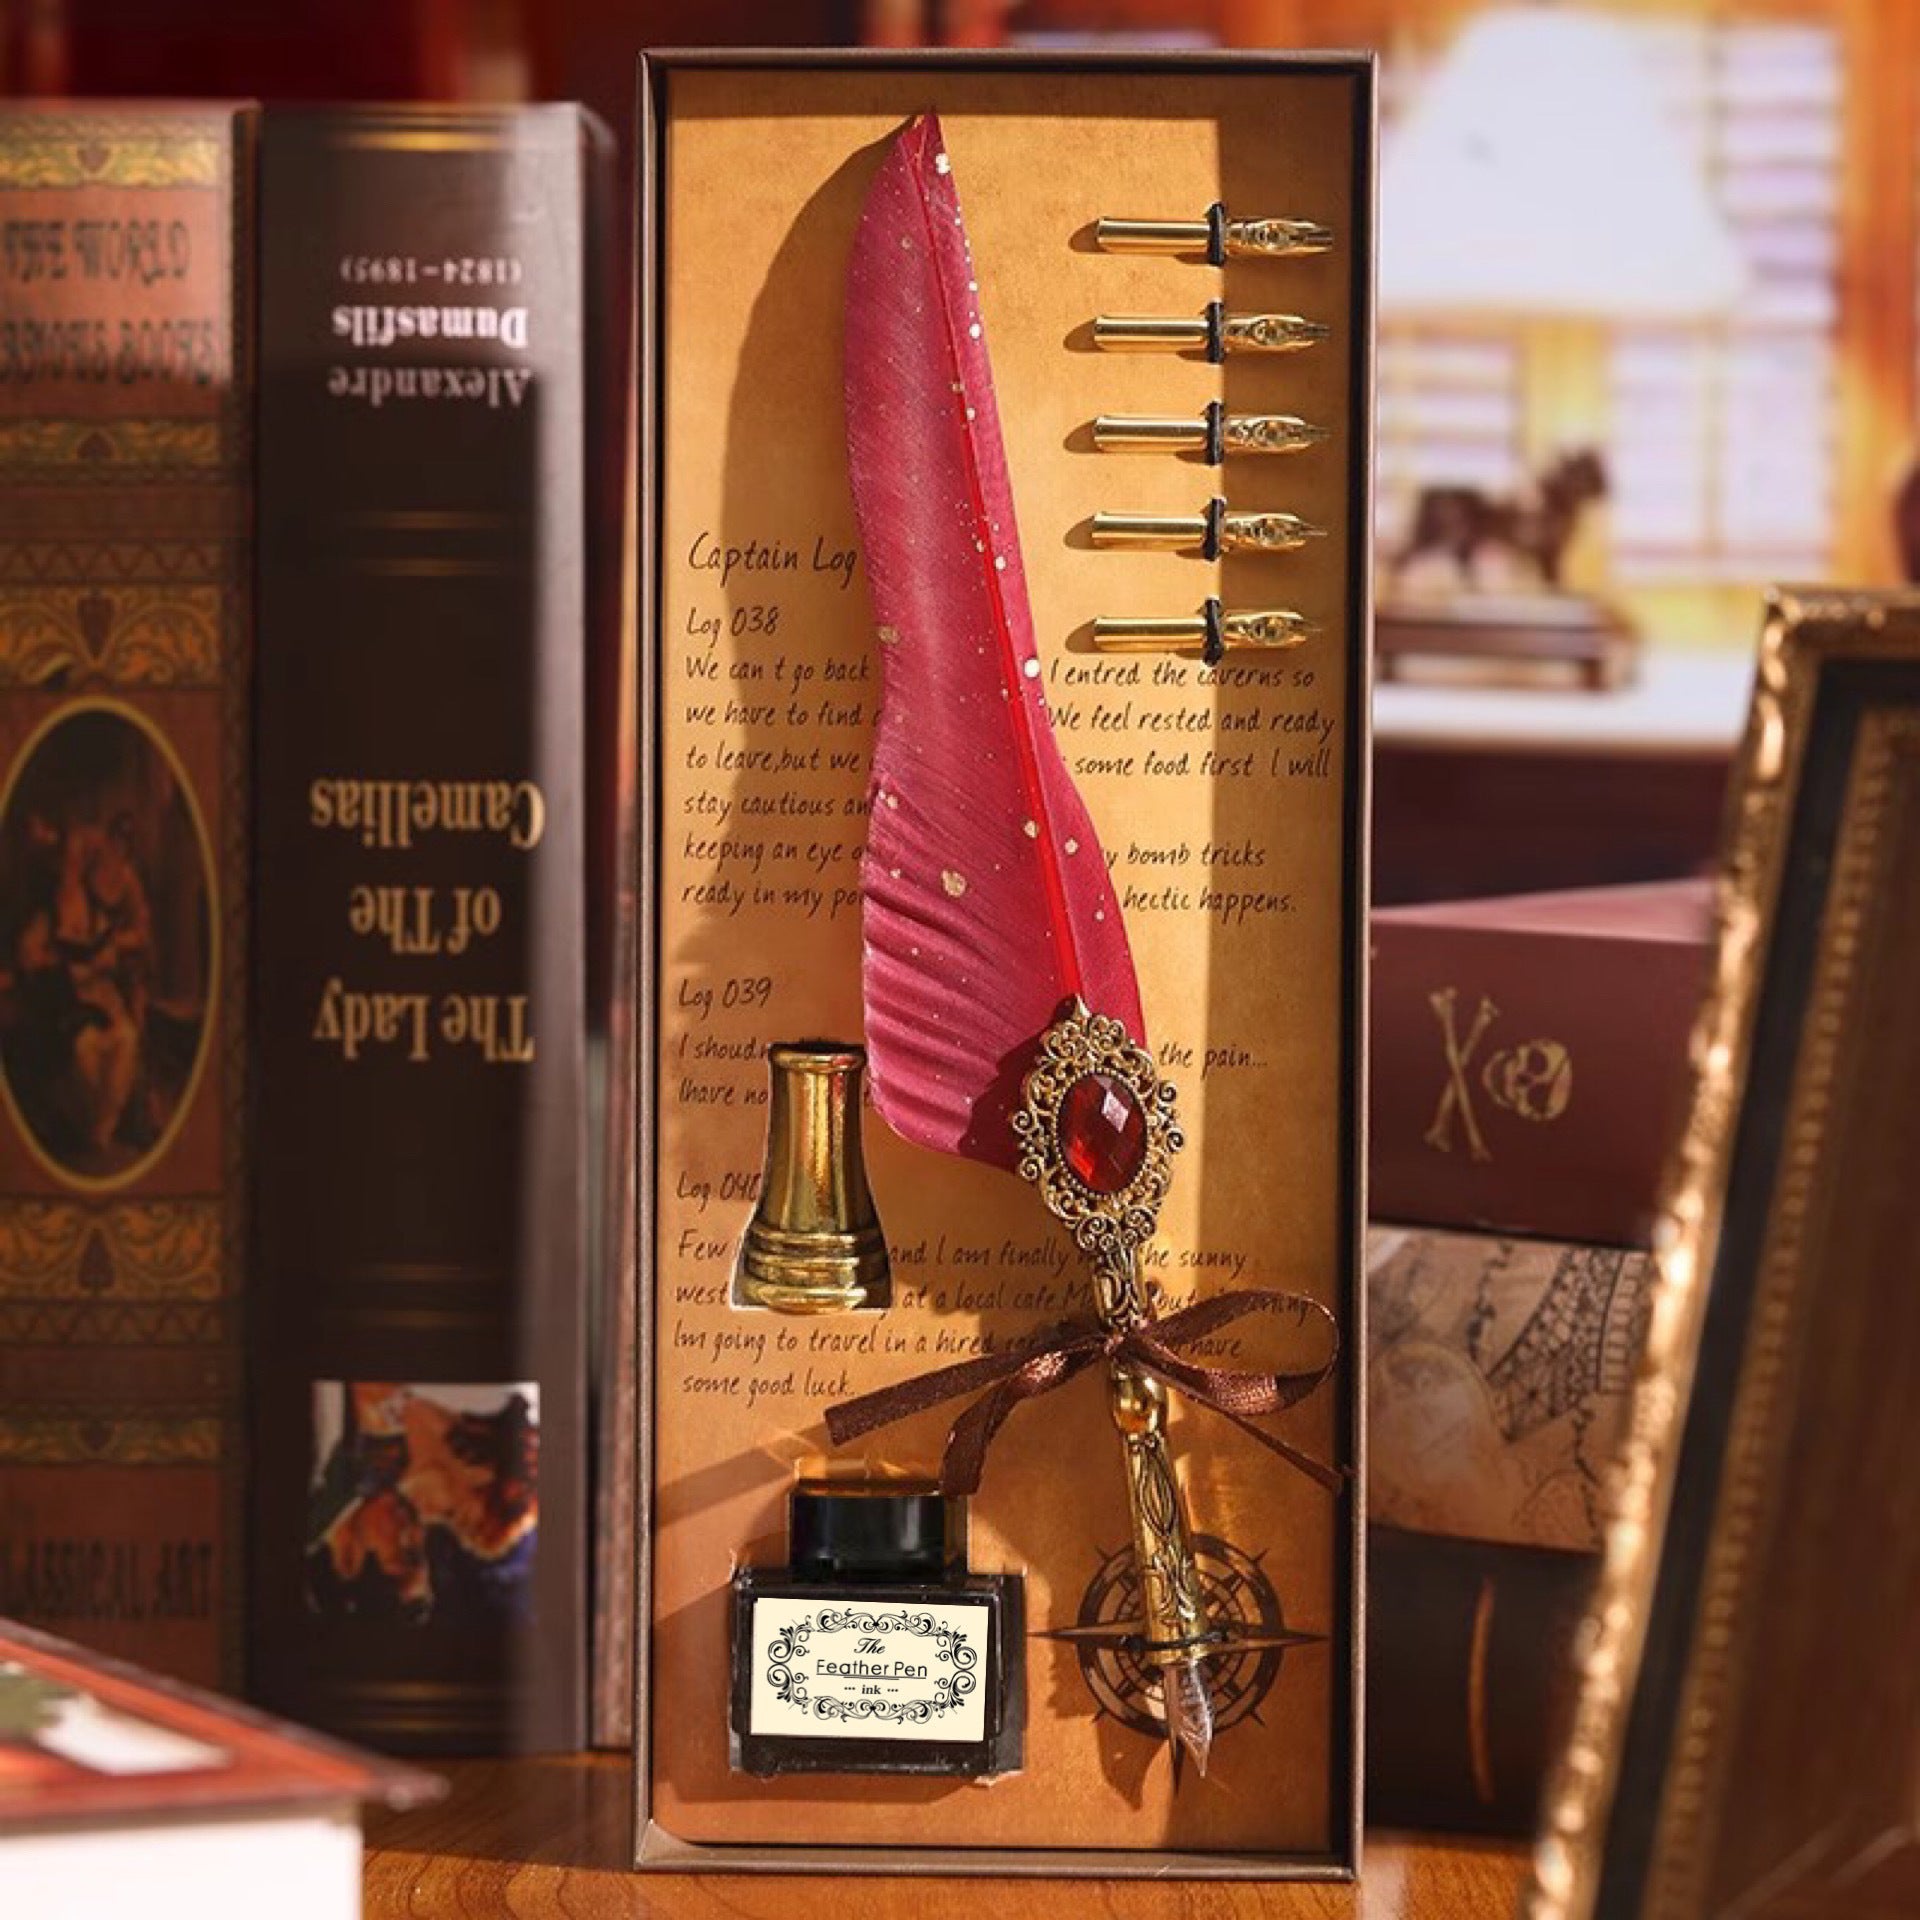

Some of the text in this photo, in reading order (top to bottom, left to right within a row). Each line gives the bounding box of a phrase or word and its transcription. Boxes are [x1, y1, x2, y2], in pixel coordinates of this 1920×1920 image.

[332, 306, 528, 348] Dumasfils
[327, 366, 532, 408] Alexandre
[688, 532, 857, 590] Captain Log
[686, 606, 780, 648] Log 038
[686, 655, 719, 680] We
[729, 660, 763, 681] can
[792, 663, 814, 694] go
[824, 655, 870, 681] back
[1064, 661, 1141, 686] entred
[1152, 660, 1187, 687] the
[1292, 669, 1315, 688] so
[686, 704, 716, 726] we
[724, 700, 775, 726] have
[786, 701, 808, 726] to
[818, 700, 863, 726] find
[1050, 702, 1081, 730] We
[1091, 702, 1132, 731] feel
[1137, 706, 1213, 732] rested
[1220, 709, 1261, 732] and
[1269, 711, 1336, 744] ready
[686, 745, 708, 769] to
[830, 747, 860, 770] we
[1074, 757, 1134, 777] some
[1143, 750, 1191, 776] food
[1200, 751, 1255, 778] first
[1288, 750, 1331, 778] will
[310, 778, 546, 850] Camellias
[683, 788, 733, 826] stay
[741, 791, 834, 817] cautious
[683, 833, 765, 874] keeping
[772, 842, 798, 860] an
[806, 842, 843, 874] eye
[1126, 841, 1192, 867] bomb
[1201, 838, 1266, 867] tricks
[350, 885, 501, 955] of The
[681, 880, 745, 918] ready
[753, 881, 775, 904] in
[782, 888, 823, 918] my
[1122, 885, 1192, 912] hectic
[1199, 885, 1297, 925] happens.
[312, 976, 536, 1062] The Lady
[679, 976, 772, 1020] Log 039
[1158, 1041, 1193, 1068] the
[1201, 1043, 1268, 1080] pain...
[676, 1170, 711, 1212] Log
[678, 1228, 728, 1260] Few
[890, 1240, 927, 1266] and
[952, 1247, 990, 1266] am
[999, 1237, 1069, 1276] finally
[1141, 1243, 1169, 1268] he
[1179, 1248, 1246, 1280] sunny
[676, 1281, 728, 1304] west
[902, 1285, 927, 1309] at
[935, 1289, 947, 1309] a
[956, 1281, 1004, 1309] local
[1013, 1284, 1056, 1309] cafe
[711, 1326, 768, 1364] going
[777, 1327, 799, 1351] to
[808, 1324, 879, 1353] travel
[885, 1330, 906, 1353] in
[916, 1334, 927, 1353] a
[935, 1329, 995, 1355] hired
[683, 1367, 857, 1409] some good luck.
[854, 1637, 886, 1655] The
[816, 1659, 928, 1678] Feather Pen
[861, 1684, 882, 1696] ink
